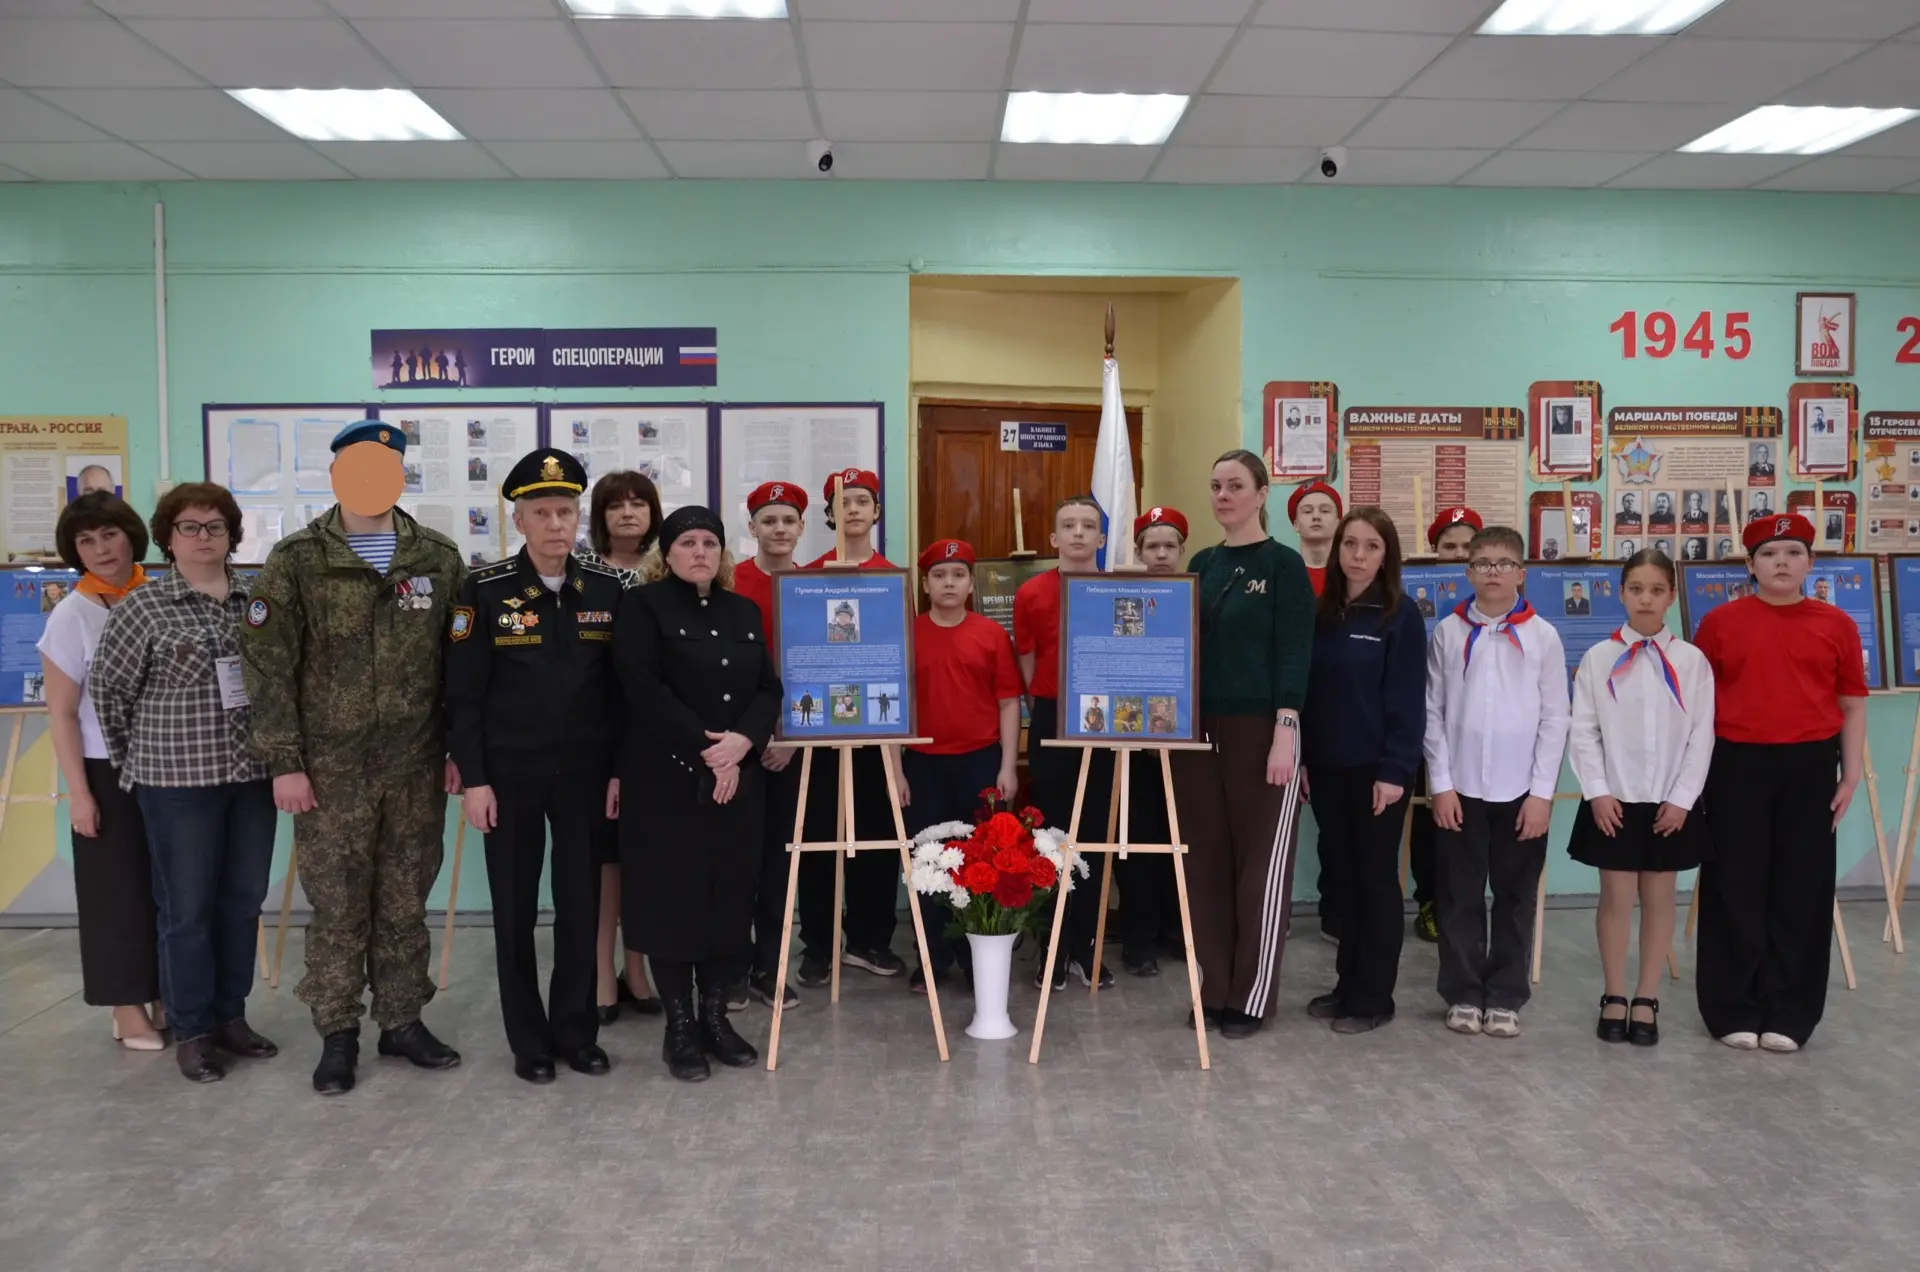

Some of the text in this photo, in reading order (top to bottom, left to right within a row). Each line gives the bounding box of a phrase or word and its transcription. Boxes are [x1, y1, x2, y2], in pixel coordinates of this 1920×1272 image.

[1609, 310, 1752, 360] 1945
[490, 347, 664, 367] ГЕРОИ СПЕЦОПЕРАЦИИ
[1349, 412, 1462, 425] ВАЖНЫЕ ДАТЫ
[1614, 411, 1738, 422] МАРШАЛЫ ПОБЕДЫ
[1869, 416, 1916, 426] 15 ГЕРОЕВ
[49, 423, 103, 434] РОССИЯ
[1003, 428, 1017, 443] 27
[1245, 579, 1267, 594] M
[982, 595, 1004, 605] ВРЕМЯ
